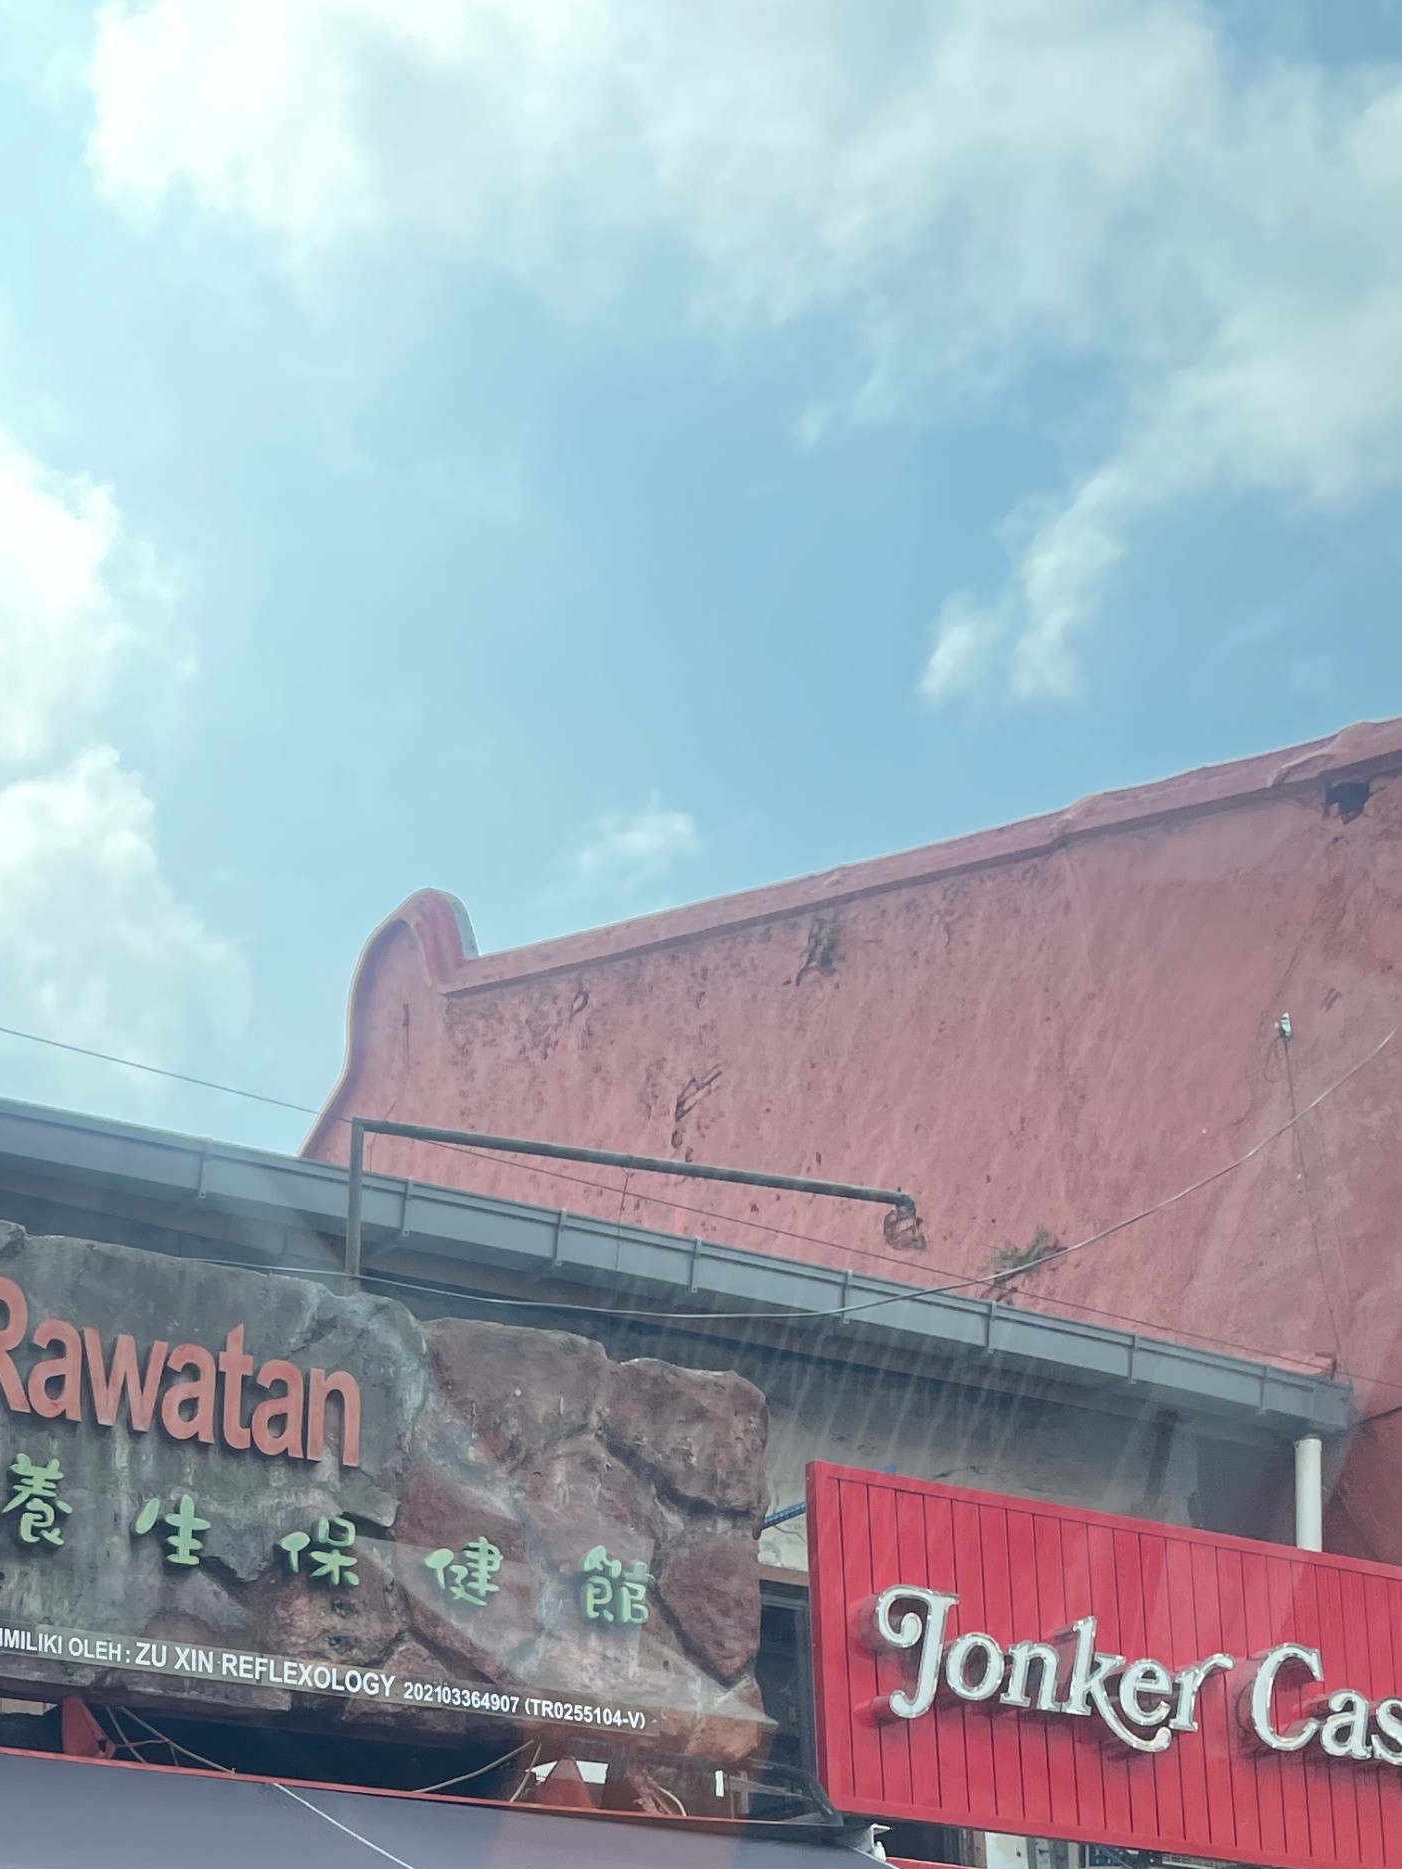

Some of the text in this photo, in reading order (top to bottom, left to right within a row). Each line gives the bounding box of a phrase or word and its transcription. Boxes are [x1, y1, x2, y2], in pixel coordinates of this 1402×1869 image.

[1, 1453, 656, 1625] 養生保健館
[135, 1642, 167, 1669] ZU
[174, 1647, 214, 1674] XIN
[221, 1653, 396, 1698] REFLEXOLOGY
[403, 1681, 520, 1714] 202103364907
[525, 1697, 646, 1730] (TR0255104-V)
[875, 1584, 1234, 1753] Jonker
